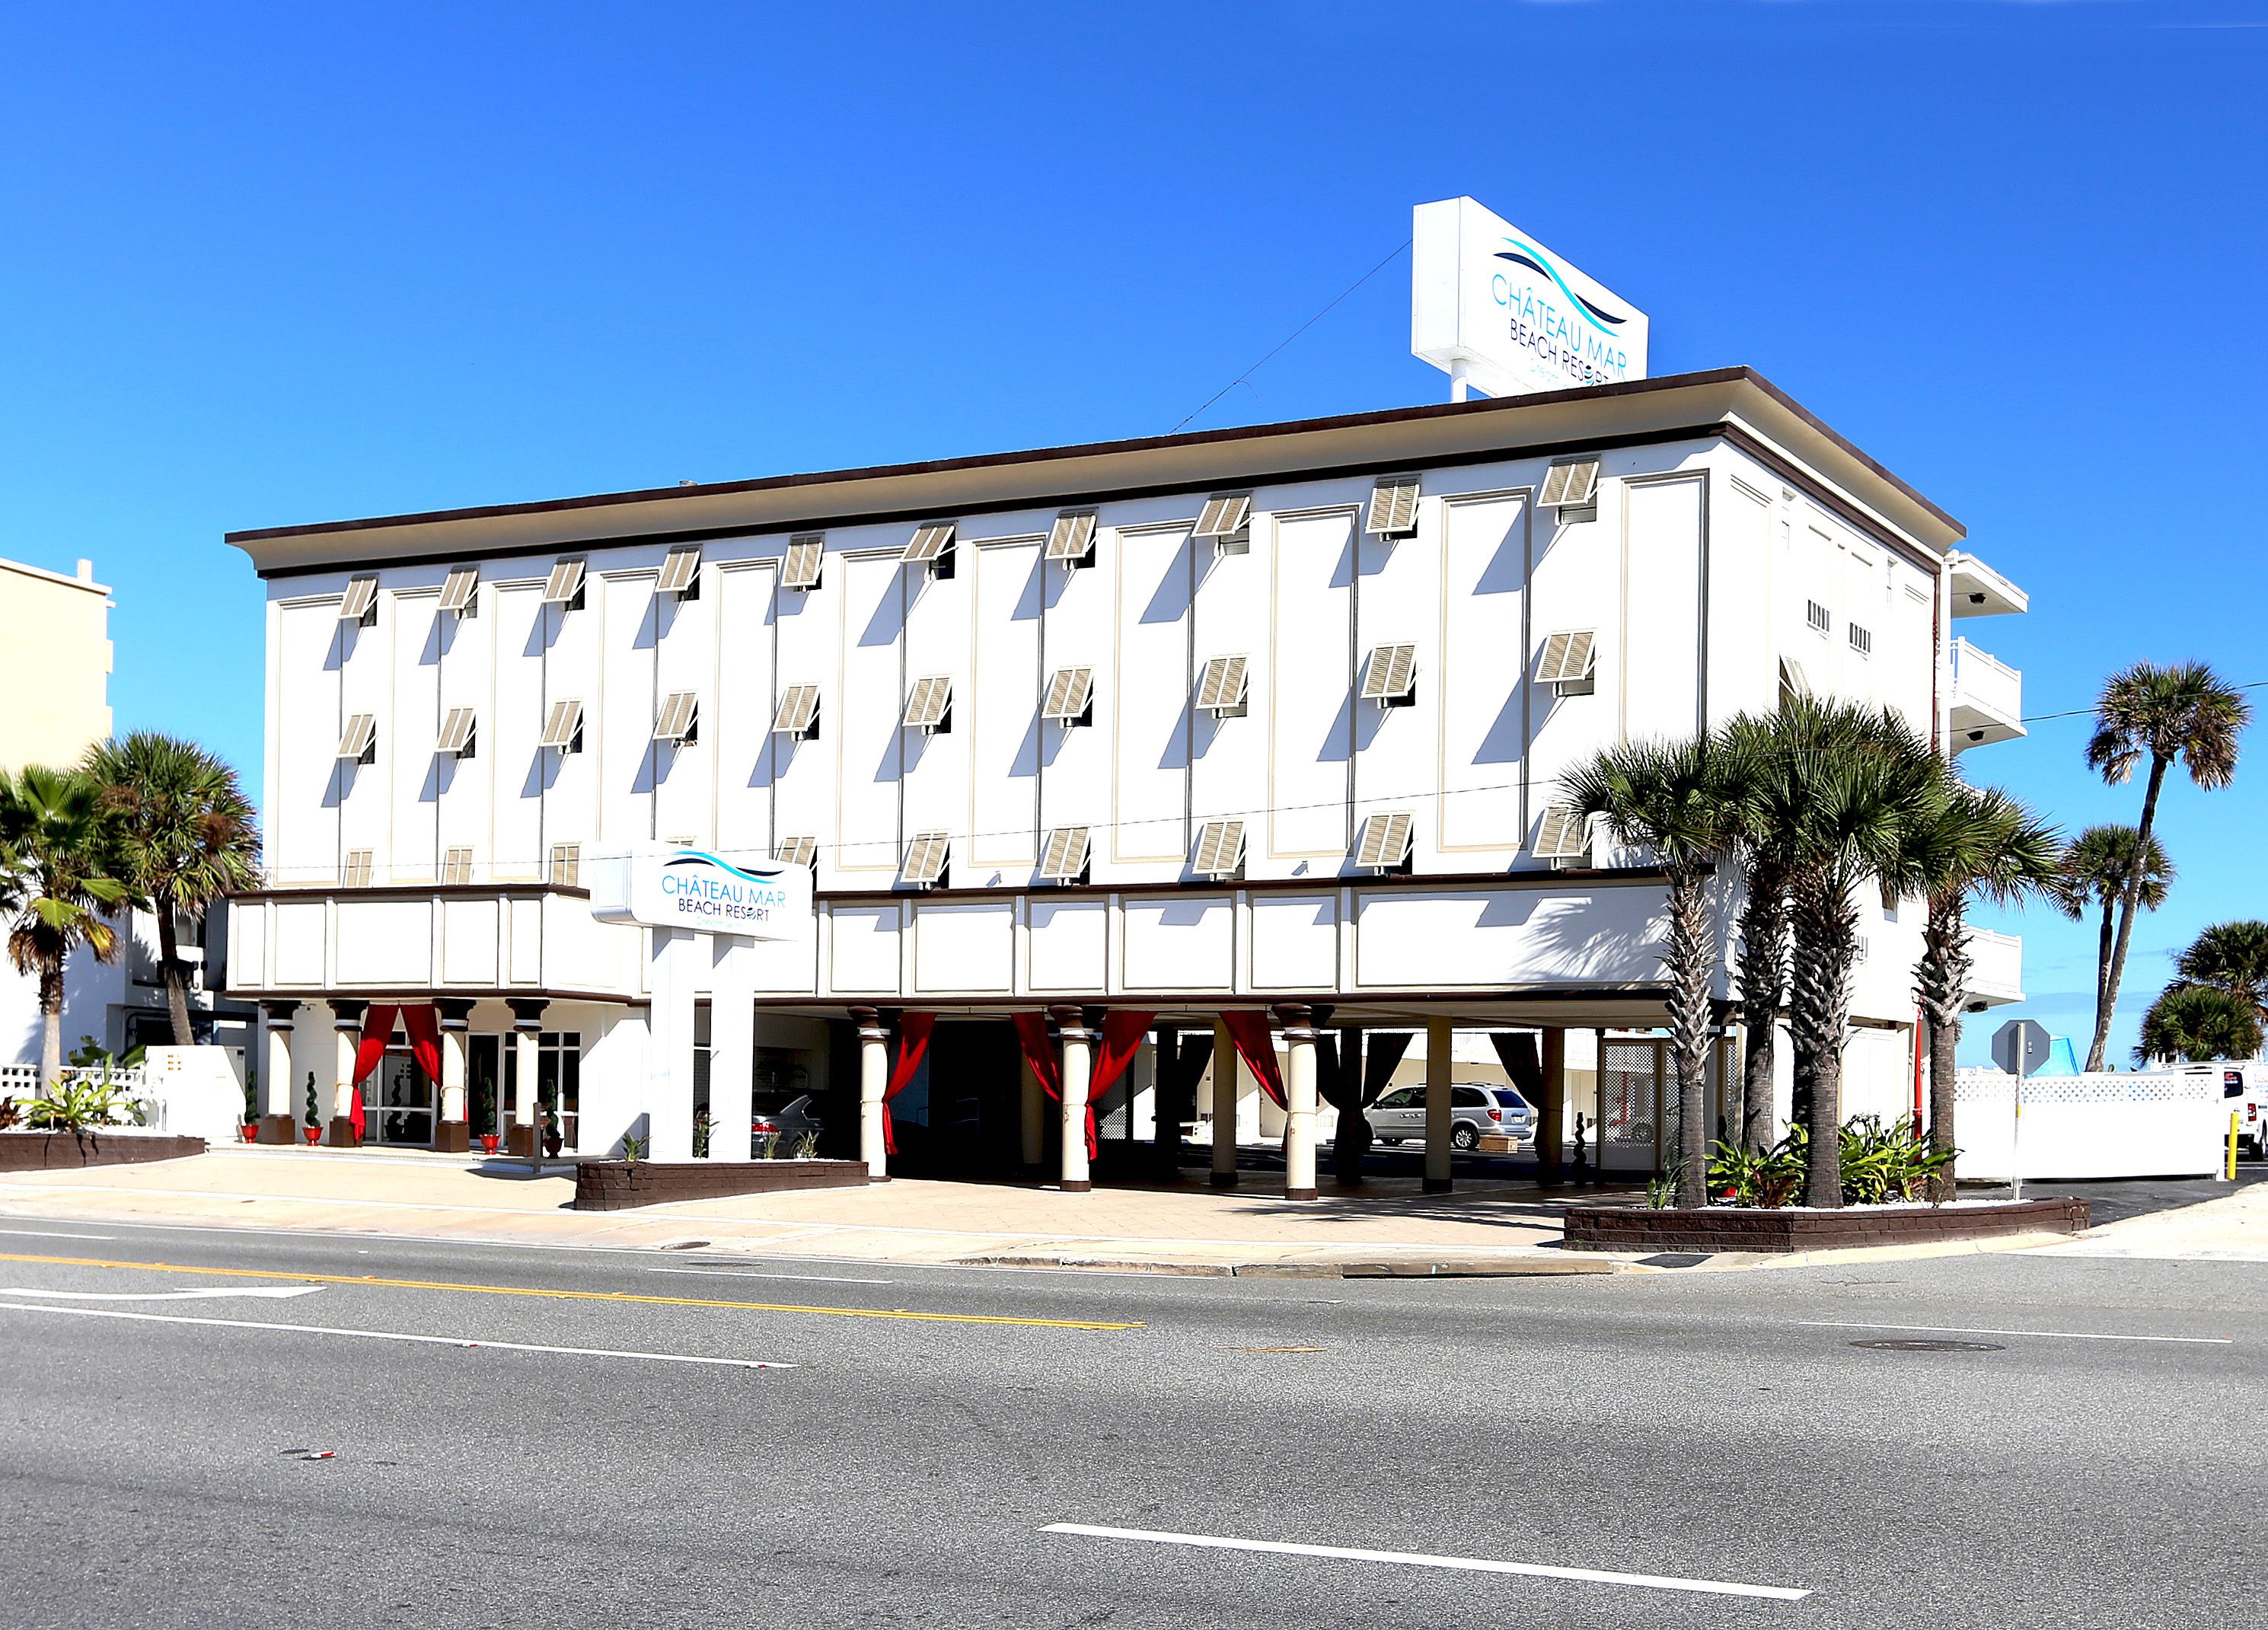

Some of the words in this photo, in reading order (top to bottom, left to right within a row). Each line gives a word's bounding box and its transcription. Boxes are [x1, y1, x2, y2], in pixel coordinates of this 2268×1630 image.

[1492, 273, 1581, 352] CHÂTEAU
[1587, 333, 1627, 380] MAR
[1510, 317, 1557, 365] BEACH
[662, 875, 742, 903] CHÂTEAU
[748, 887, 786, 908] MAR
[678, 898, 721, 916] BEACH
[726, 904, 770, 922] RESORT
